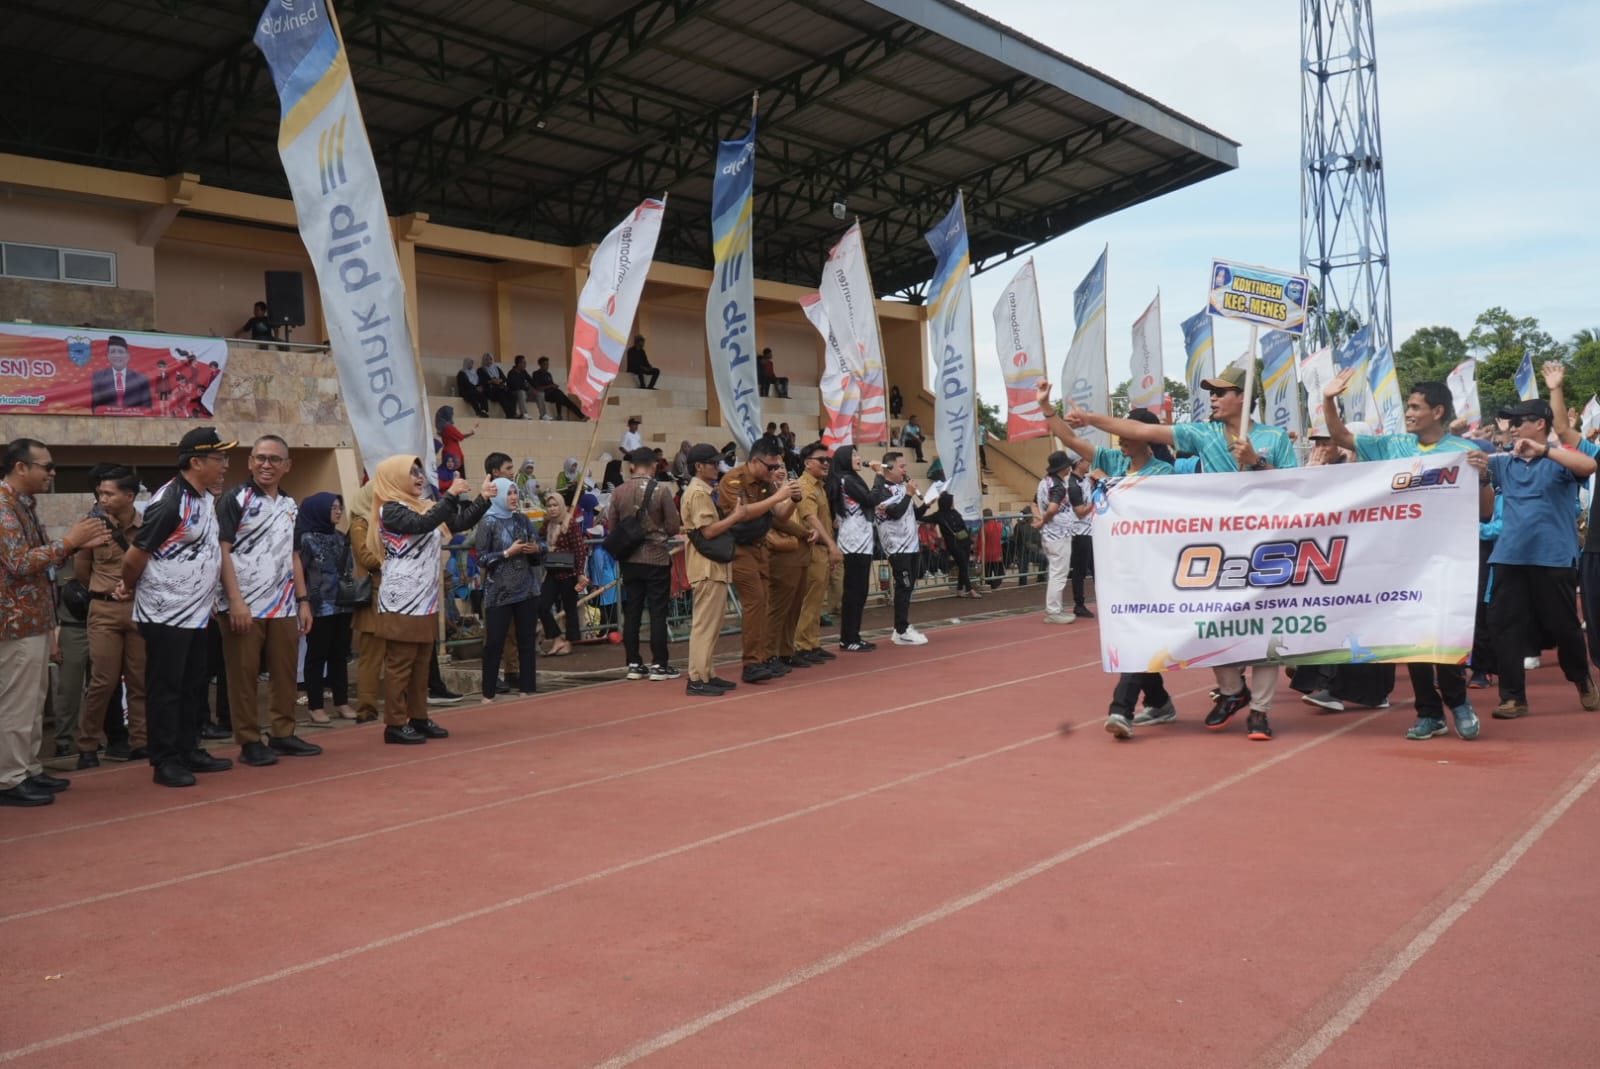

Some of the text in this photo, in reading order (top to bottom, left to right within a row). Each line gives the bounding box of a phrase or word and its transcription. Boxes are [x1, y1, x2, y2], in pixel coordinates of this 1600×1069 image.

[1231, 275, 1284, 301] KONTINGEN
[1223, 291, 1287, 321] KEC. MENES
[32, 360, 55, 377] SD
[1391, 466, 1459, 490] O2SN
[1111, 503, 1422, 536] KONTINGEN KECAMATAN MENES
[1173, 536, 1348, 591] O2SN
[1111, 590, 1423, 614] OLIMPIADE OLAHRAGA SISWA NASIONAL (O2SN)
[1194, 614, 1327, 639] TAHUN 2026
